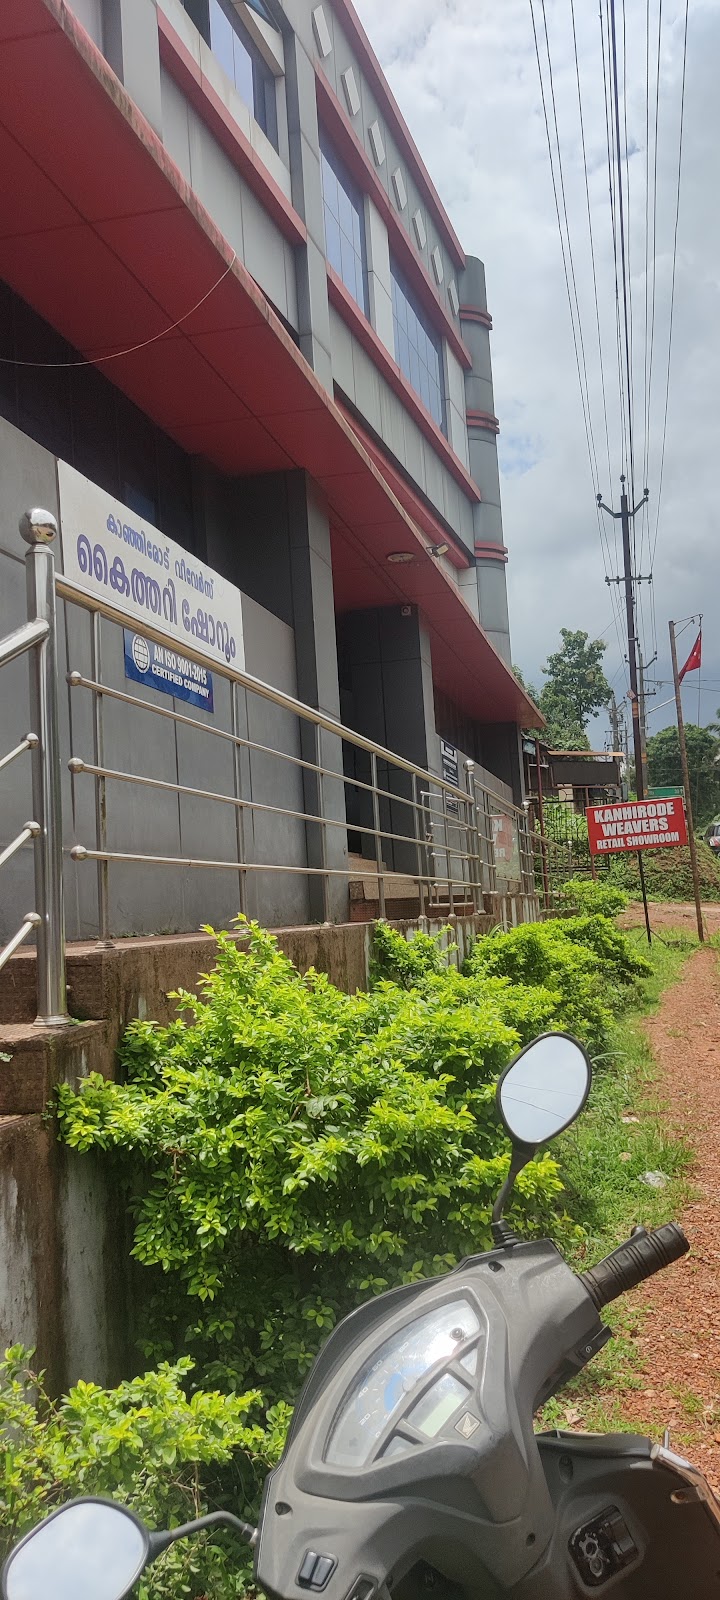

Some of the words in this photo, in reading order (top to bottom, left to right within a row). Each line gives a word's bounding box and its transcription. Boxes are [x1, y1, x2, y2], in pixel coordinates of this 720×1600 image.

[106, 513, 170, 571] കാഞ്ഞിരോട്
[76, 533, 178, 626] കൈത്തറി
[181, 598, 236, 663] ഷോറൂം
[154, 644, 164, 665] AN
[164, 649, 176, 670] ISO
[177, 656, 208, 686] 9001-2015
[152, 663, 183, 687] CERTIFIED
[183, 678, 210, 699] COMPANY
[593, 801, 675, 824] KANHIRODE
[601, 817, 669, 837] WEAVERS
[596, 838, 626, 850] RETAIL
[626, 831, 680, 847] SHOWROOM
[358, 1386, 369, 1399] 40
[358, 1412, 371, 1426] 20
